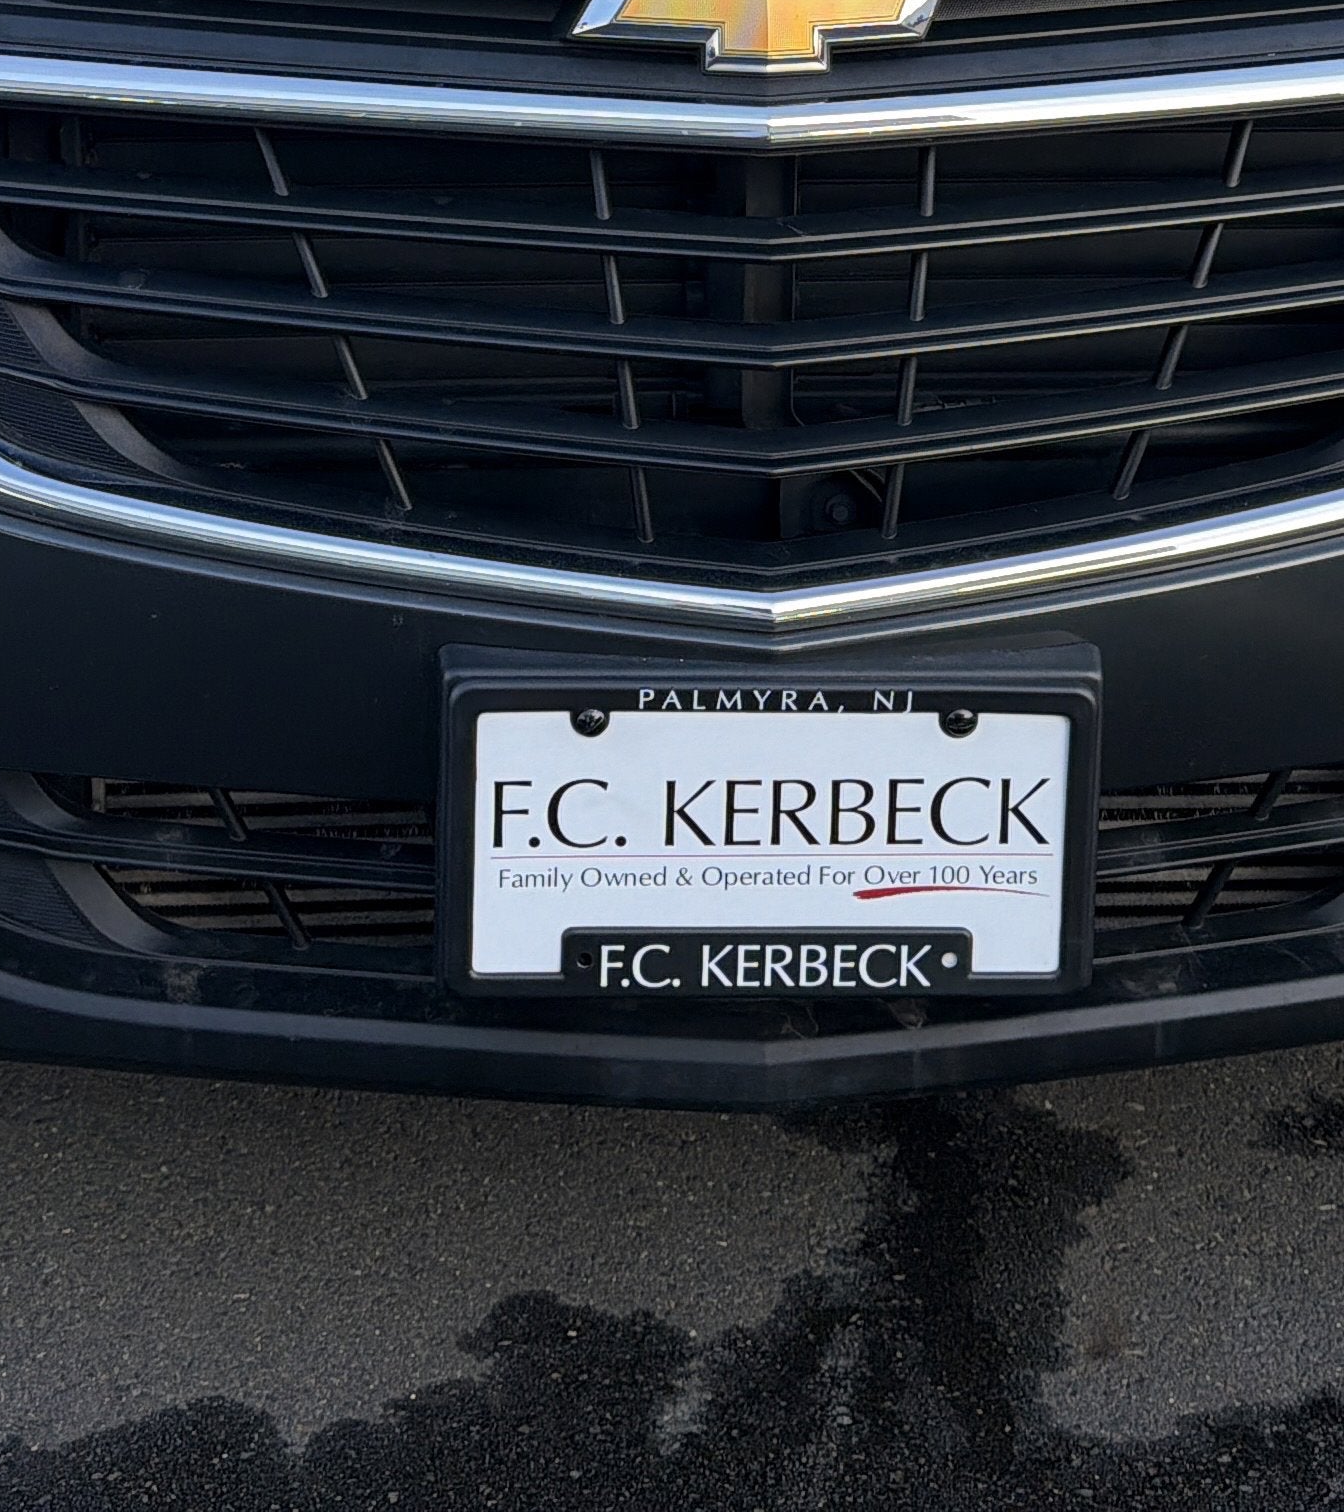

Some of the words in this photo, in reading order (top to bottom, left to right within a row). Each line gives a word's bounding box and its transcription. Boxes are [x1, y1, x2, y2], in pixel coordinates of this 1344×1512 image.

[638, 688, 845, 714] PALMYRA,
[873, 689, 913, 715] NJ
[492, 778, 627, 849] F.C.
[664, 776, 1051, 847] KERBECK
[499, 866, 573, 892] Family
[580, 866, 667, 888] Owned
[675, 867, 693, 887] &
[701, 864, 811, 890] Operated
[819, 865, 856, 886] For
[864, 865, 921, 885] Over
[929, 865, 971, 885] 100
[978, 865, 1039, 885] Years
[599, 944, 681, 988] F.C.
[701, 943, 932, 988] KERBECK
